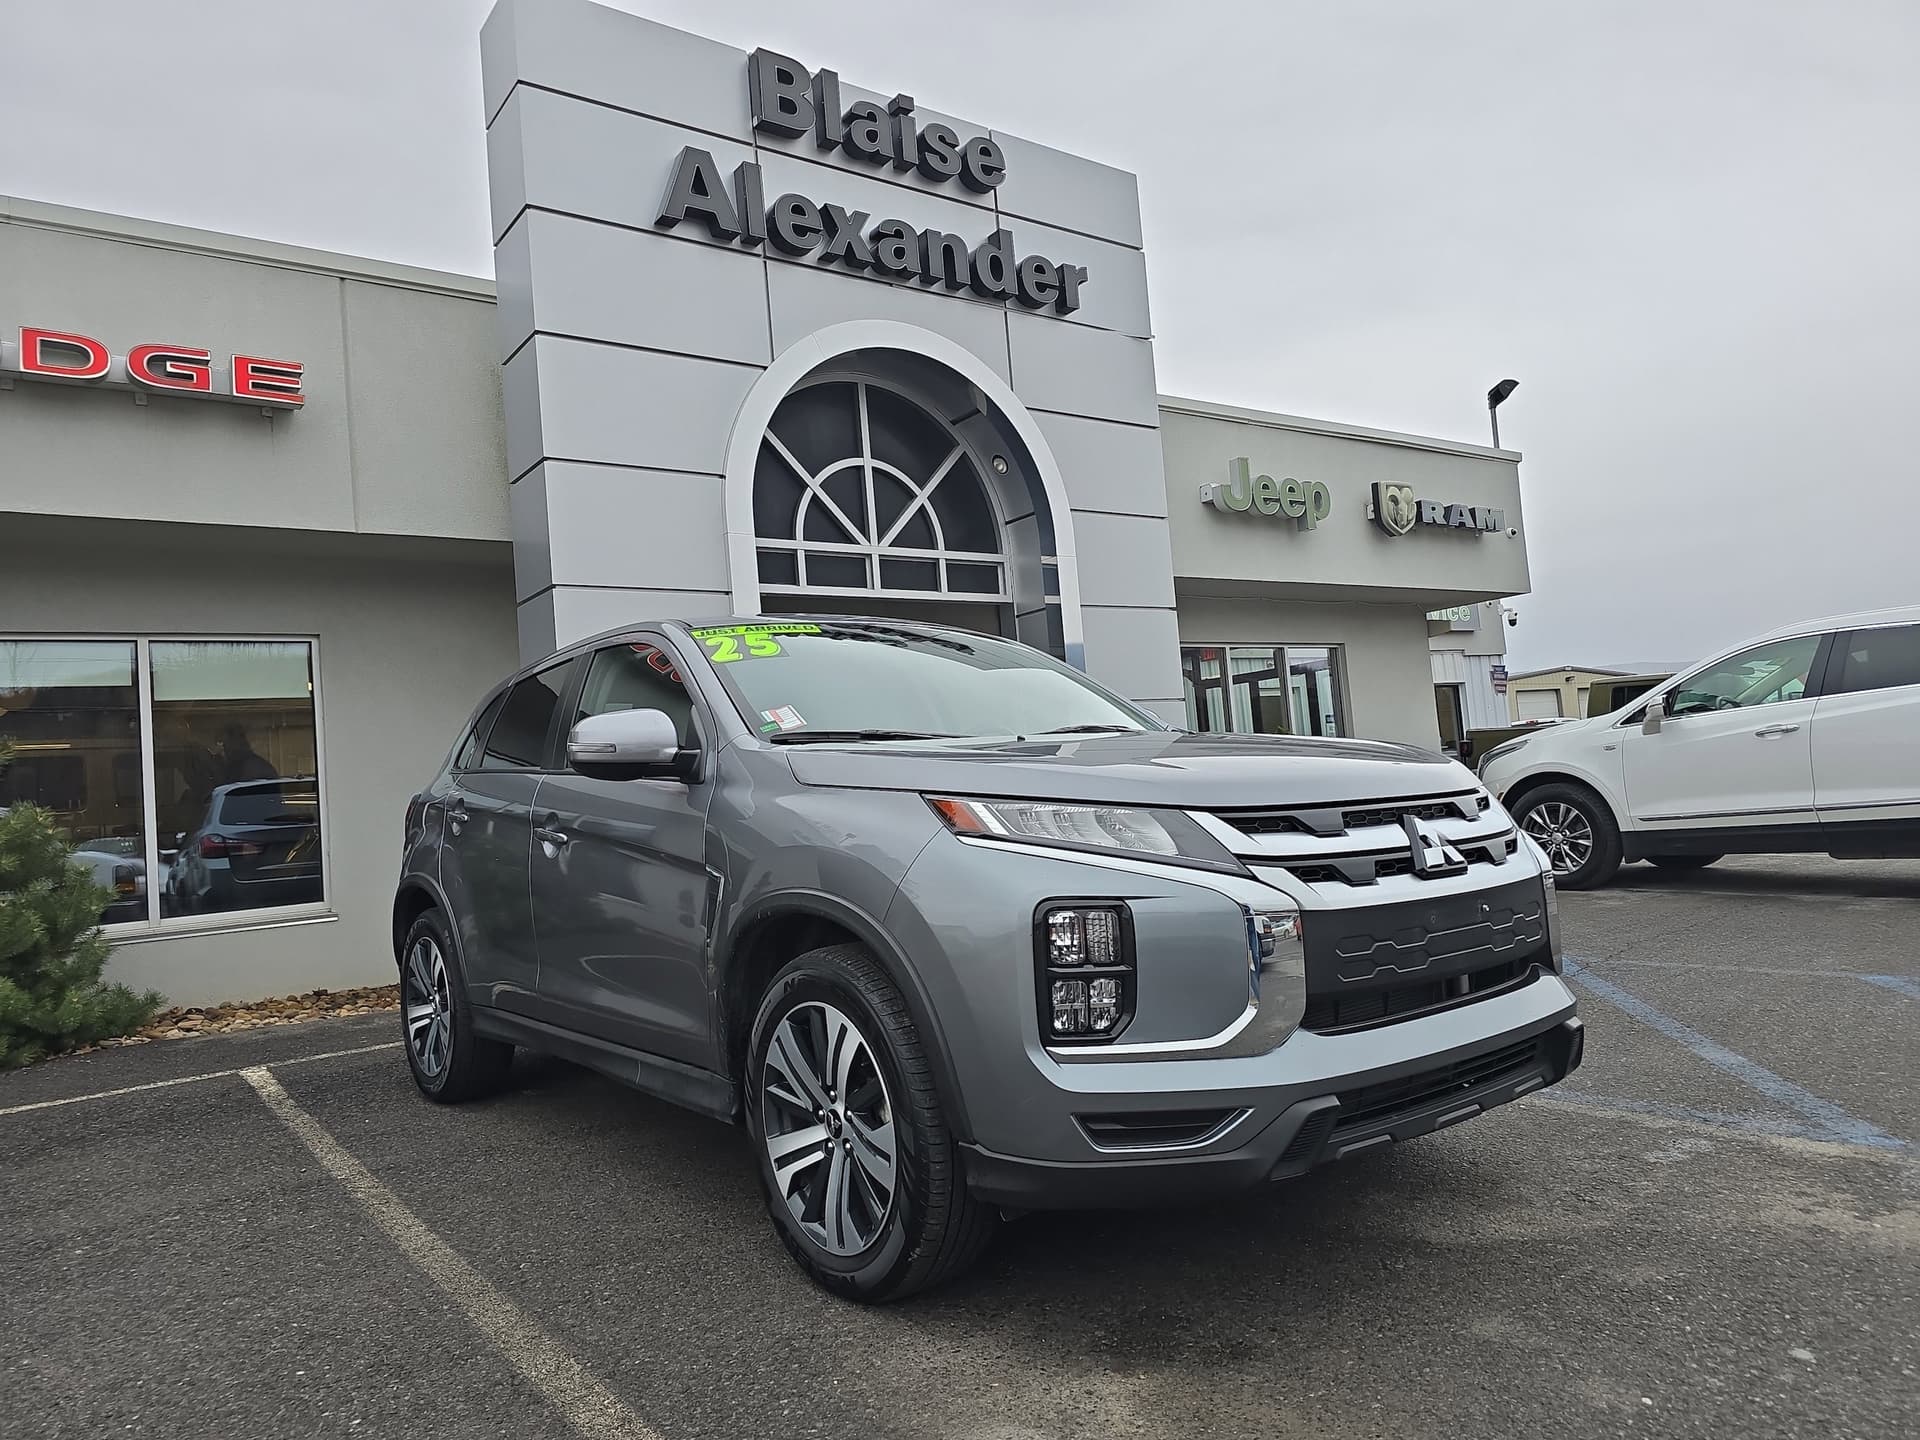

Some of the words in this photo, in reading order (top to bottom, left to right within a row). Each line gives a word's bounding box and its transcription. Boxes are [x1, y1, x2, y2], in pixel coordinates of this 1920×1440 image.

[749, 47, 1006, 194] Blaise
[655, 145, 1088, 315] Alexander
[1211, 457, 1331, 531] Jeep
[1416, 499, 1504, 533] RAM
[695, 628, 737, 637] JUST
[744, 624, 814, 633] ARRIVED
[705, 634, 781, 662] 25
